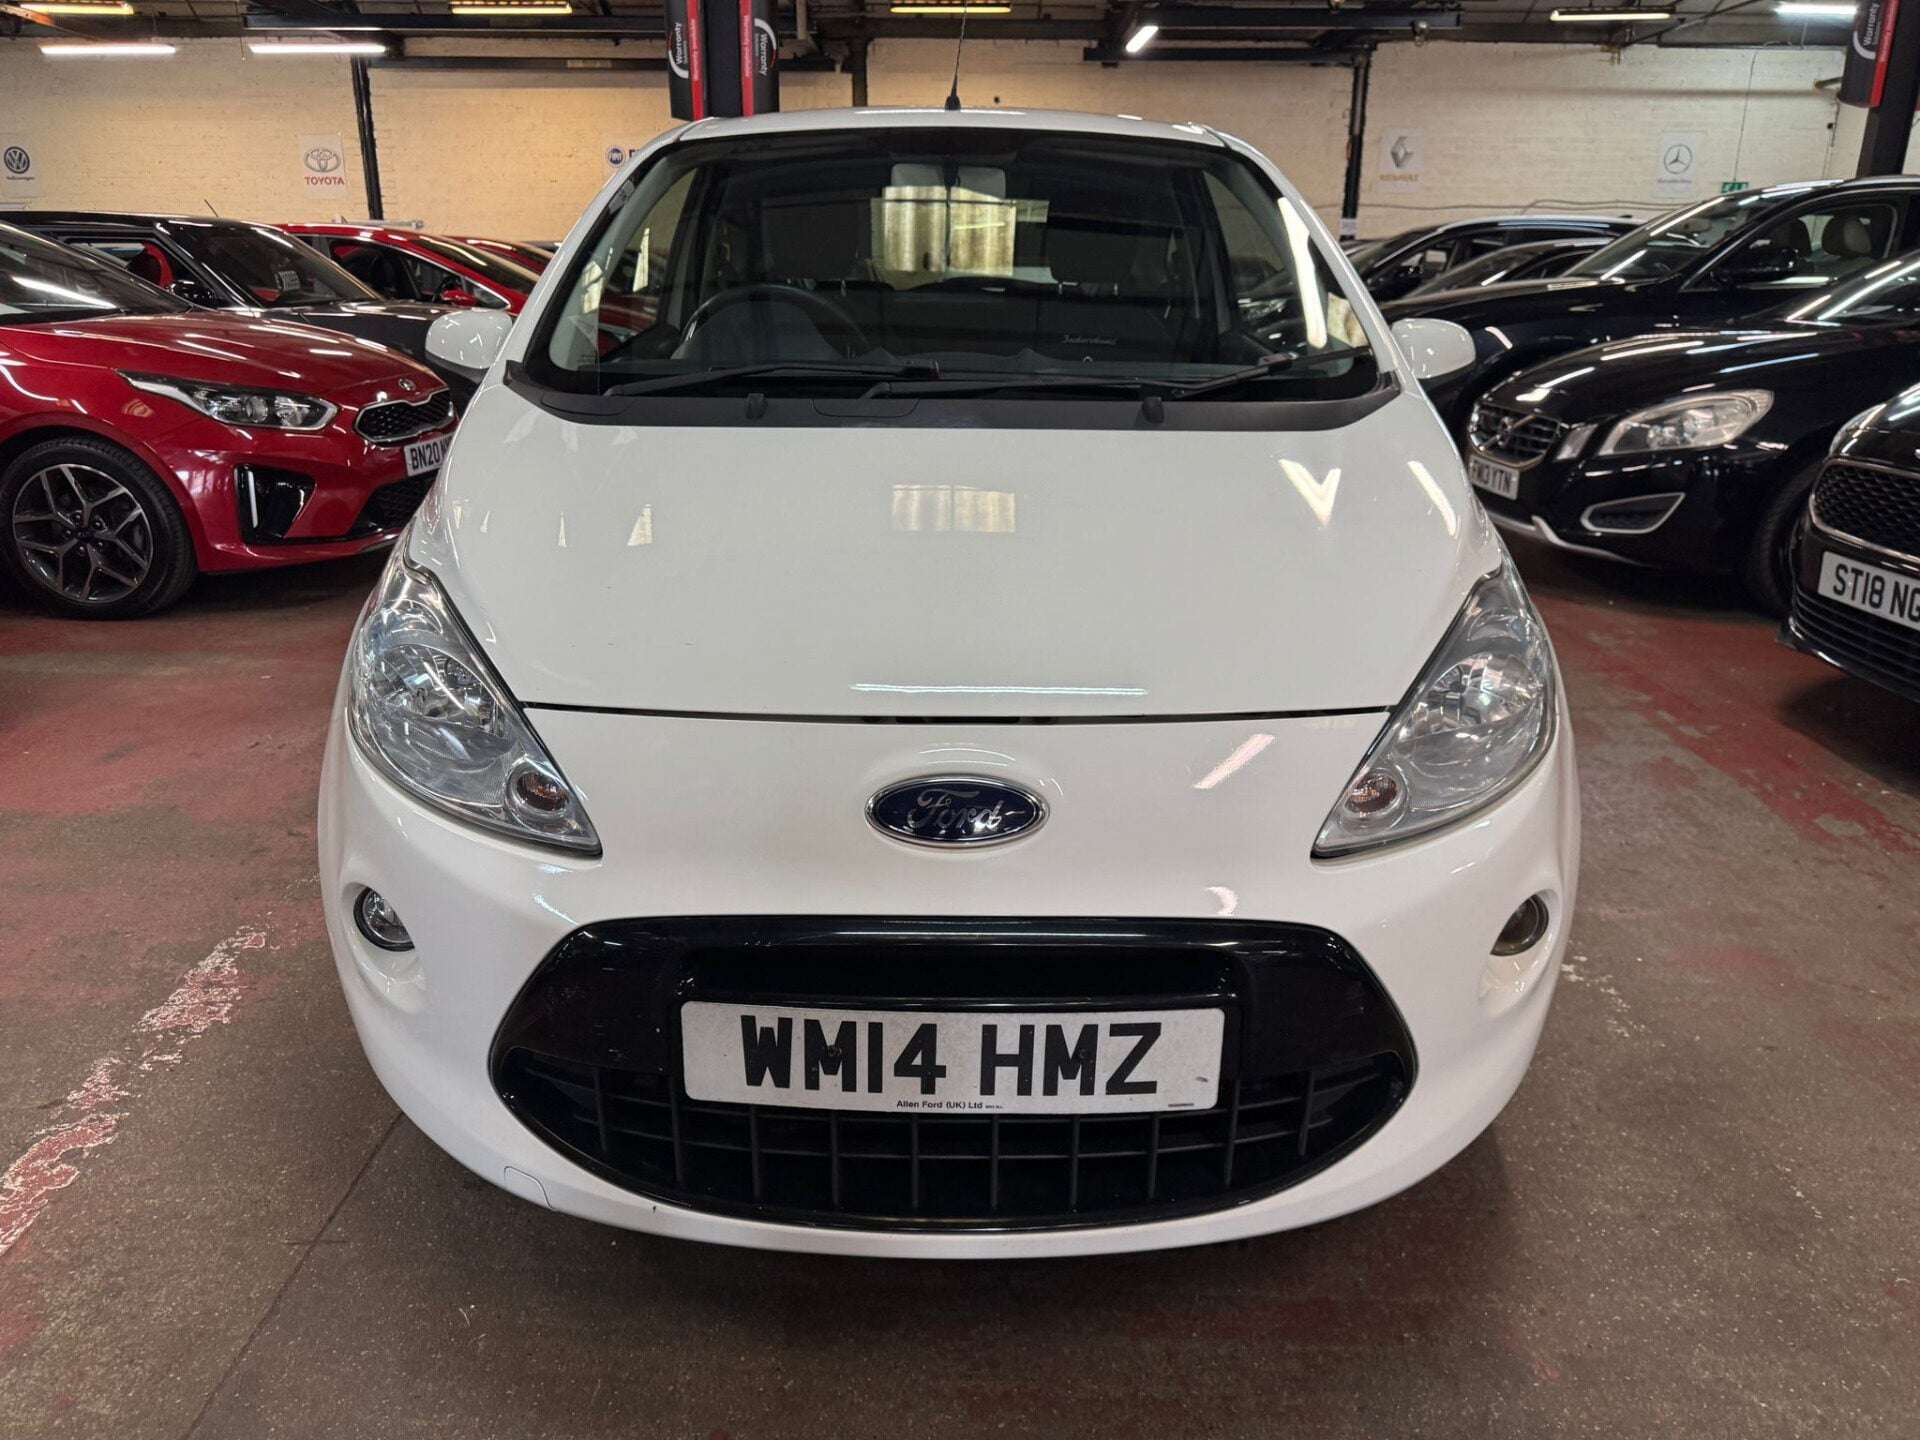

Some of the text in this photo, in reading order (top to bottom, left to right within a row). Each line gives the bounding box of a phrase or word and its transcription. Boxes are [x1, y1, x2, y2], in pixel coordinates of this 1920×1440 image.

[674, 22, 683, 65] Warranty
[1863, 3, 1880, 46] Warranty
[759, 33, 768, 76] Warranty
[304, 176, 345, 185] TOYOTA
[410, 442, 440, 470] BN20
[1833, 563, 1885, 609] ST18
[907, 788, 1012, 832] Ford
[740, 1015, 1162, 1097] WM14 HMZ
[896, 1100, 920, 1109] Allen
[922, 1101, 943, 1109] Ford
[946, 1101, 966, 1110] (UK)
[968, 1101, 983, 1109] Ltd
